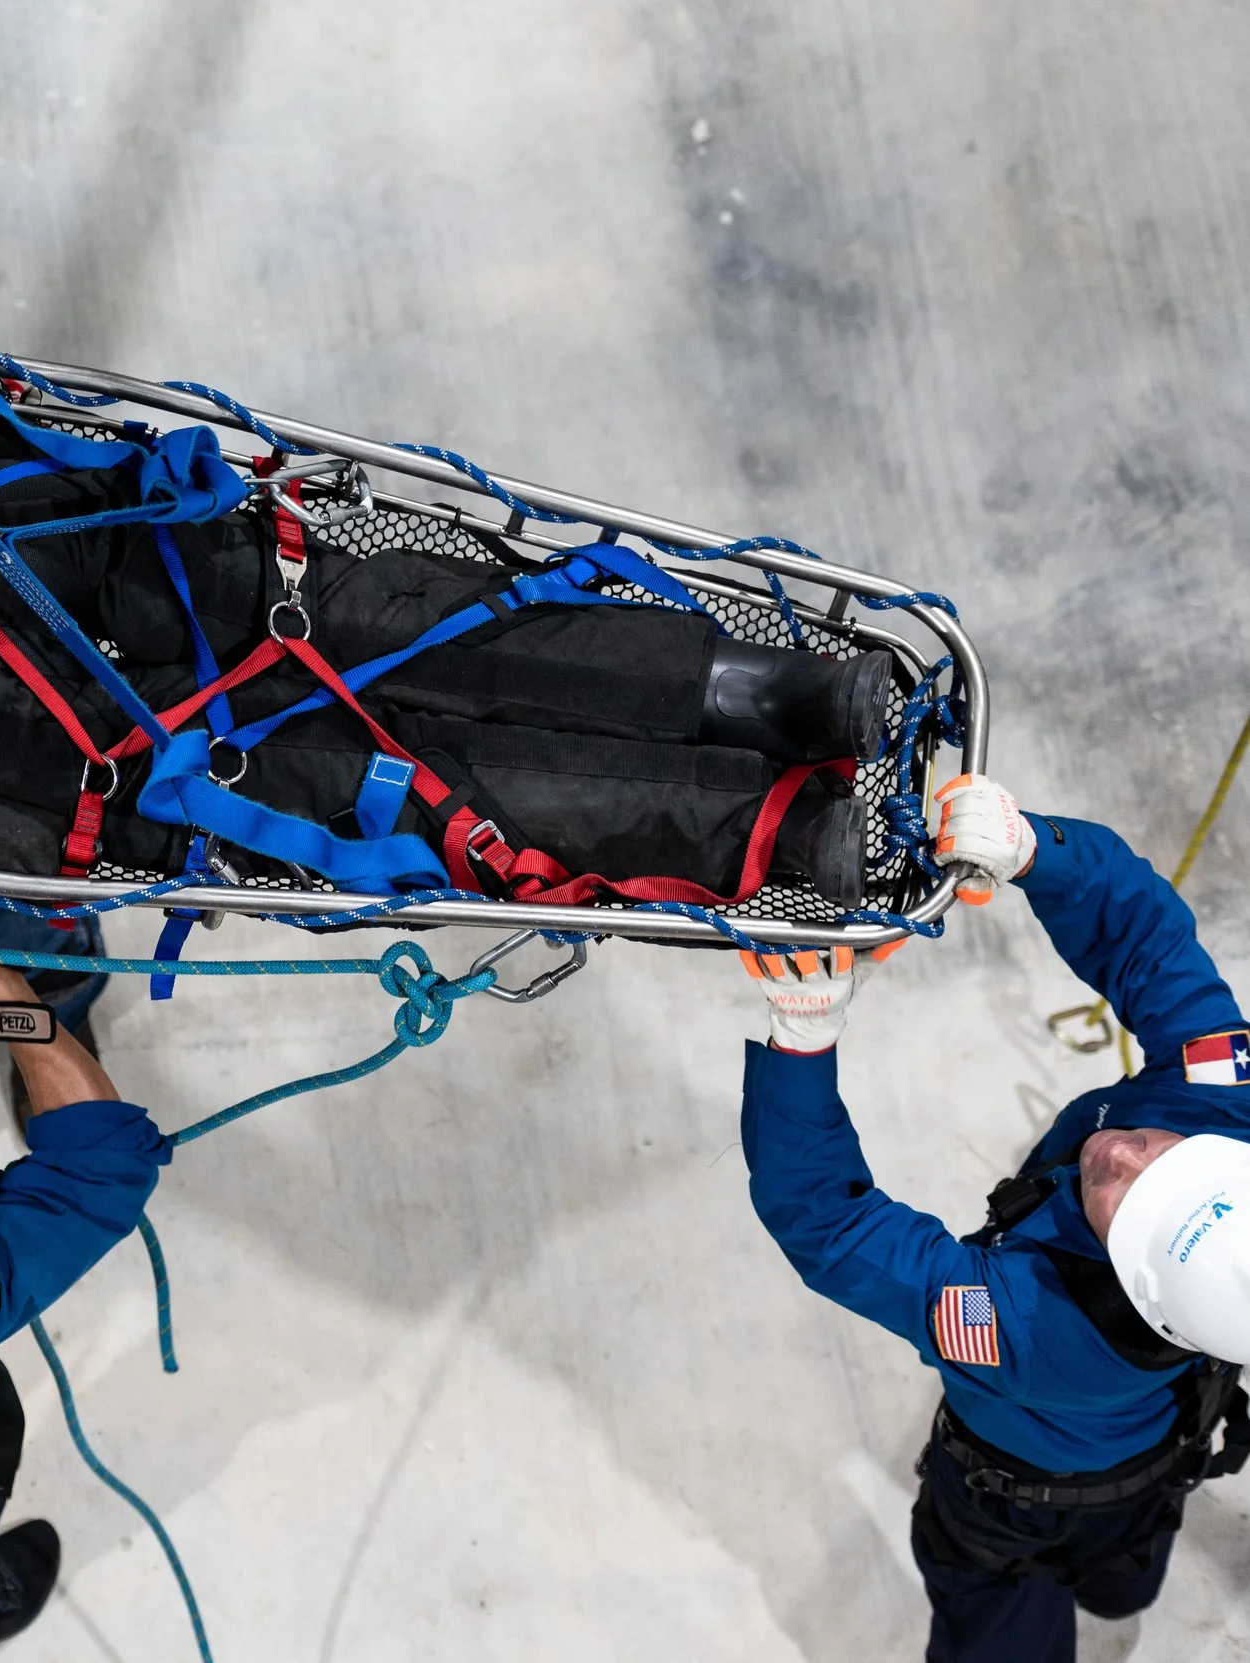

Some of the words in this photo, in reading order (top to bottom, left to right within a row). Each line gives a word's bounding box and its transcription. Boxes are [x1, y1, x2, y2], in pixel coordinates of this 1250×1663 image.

[998, 793, 1017, 845] WATCH
[774, 994, 831, 1006] WATCH
[1207, 1190, 1227, 1204] Port
[1187, 1203, 1208, 1223] Arthur
[1167, 1223, 1189, 1257] Refinery
[1179, 1222, 1213, 1263] Valero
